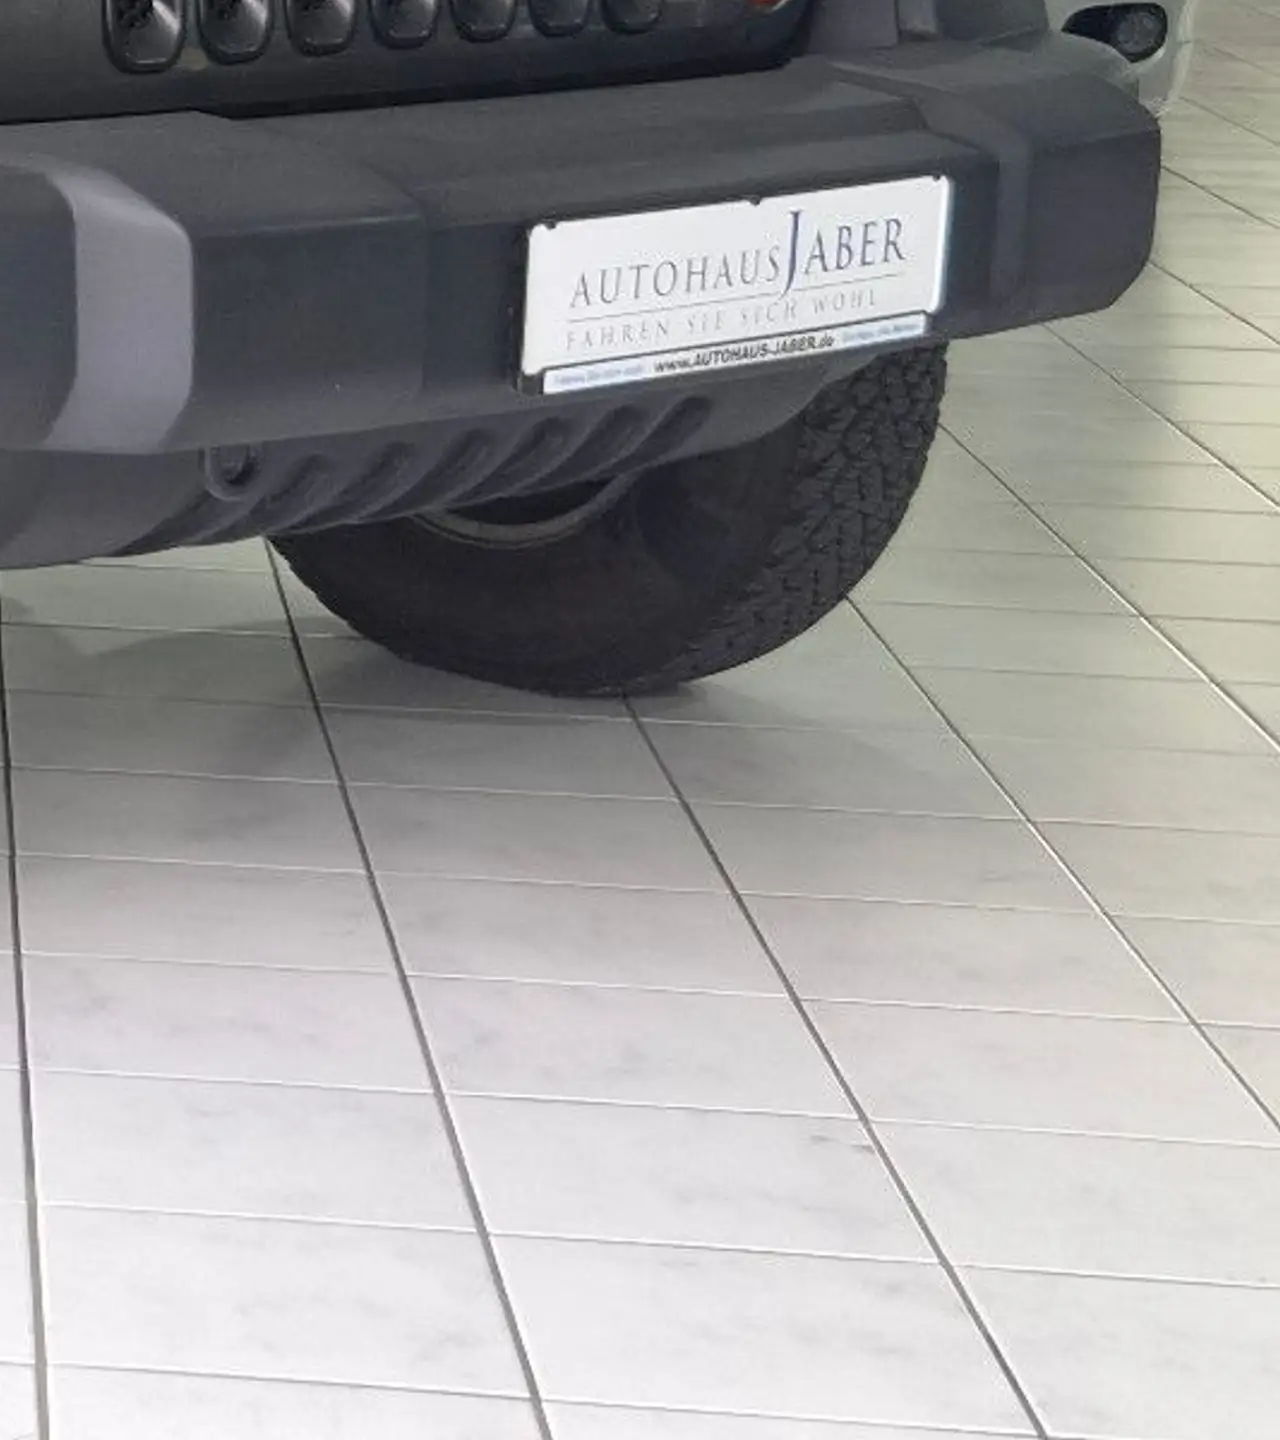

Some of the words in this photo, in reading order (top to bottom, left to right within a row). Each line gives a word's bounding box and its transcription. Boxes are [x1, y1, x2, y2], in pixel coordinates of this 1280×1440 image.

[569, 244, 781, 308] AUTOHAUS
[781, 209, 906, 299] JABER
[566, 320, 668, 351] FAHREN
[687, 311, 725, 333] SIE
[812, 288, 877, 315] WOHL
[654, 333, 835, 373] www.AUTOHAUS-JABER.de
